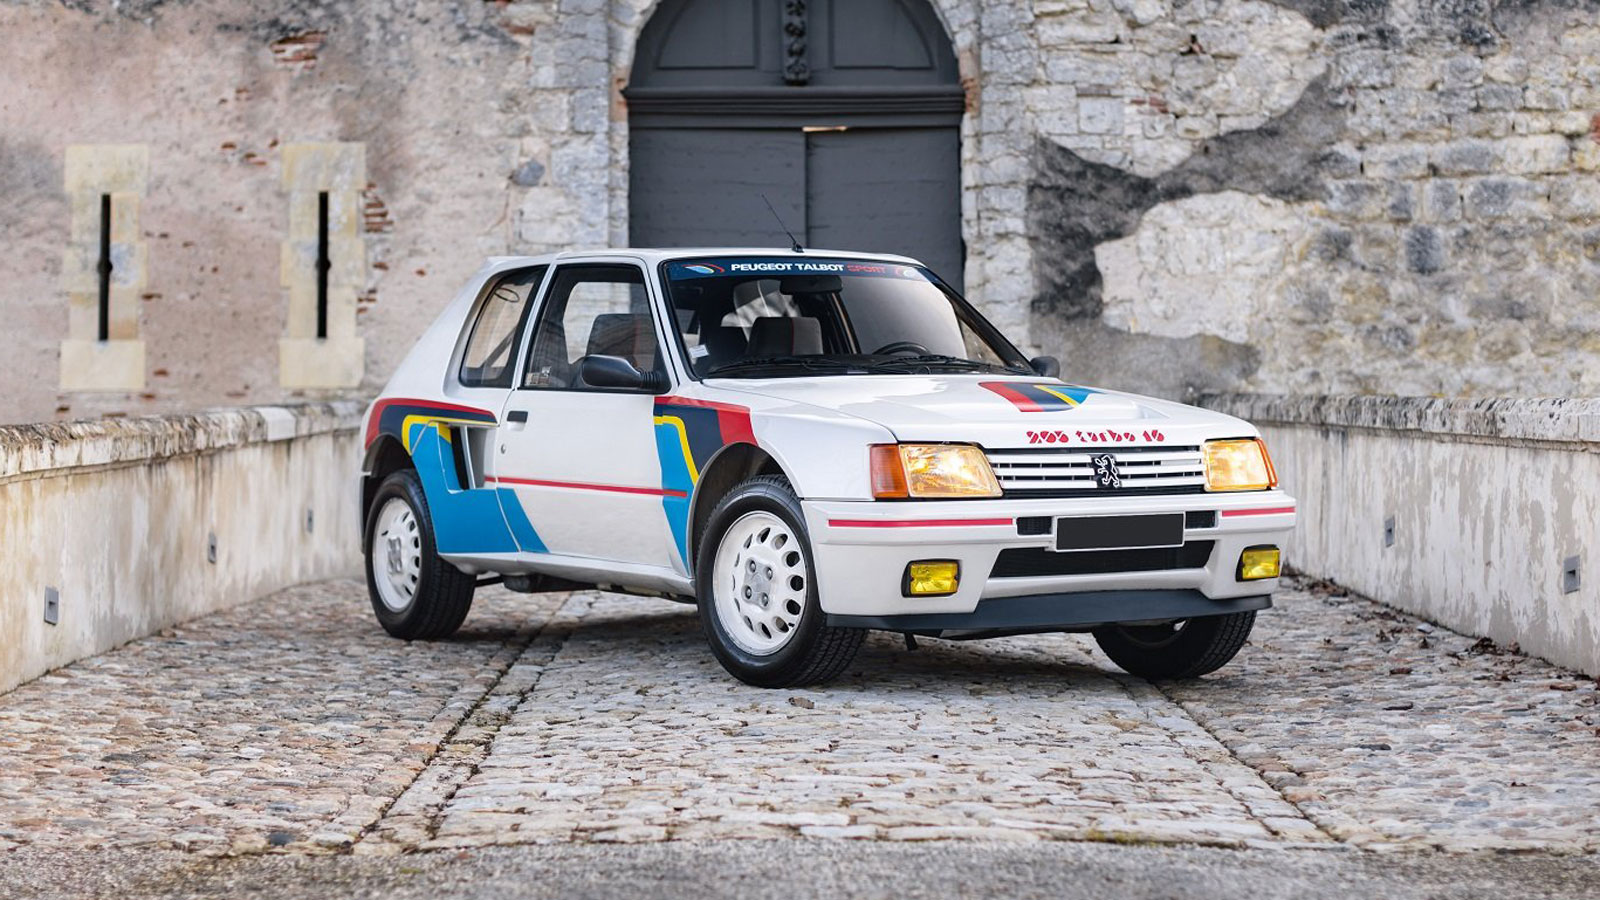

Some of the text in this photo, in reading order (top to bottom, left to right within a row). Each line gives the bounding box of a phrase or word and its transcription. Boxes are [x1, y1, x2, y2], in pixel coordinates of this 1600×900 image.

[731, 263, 885, 273] PEUGEOT TALBOT SPORT
[1026, 429, 1165, 444] 205 turbo 16
